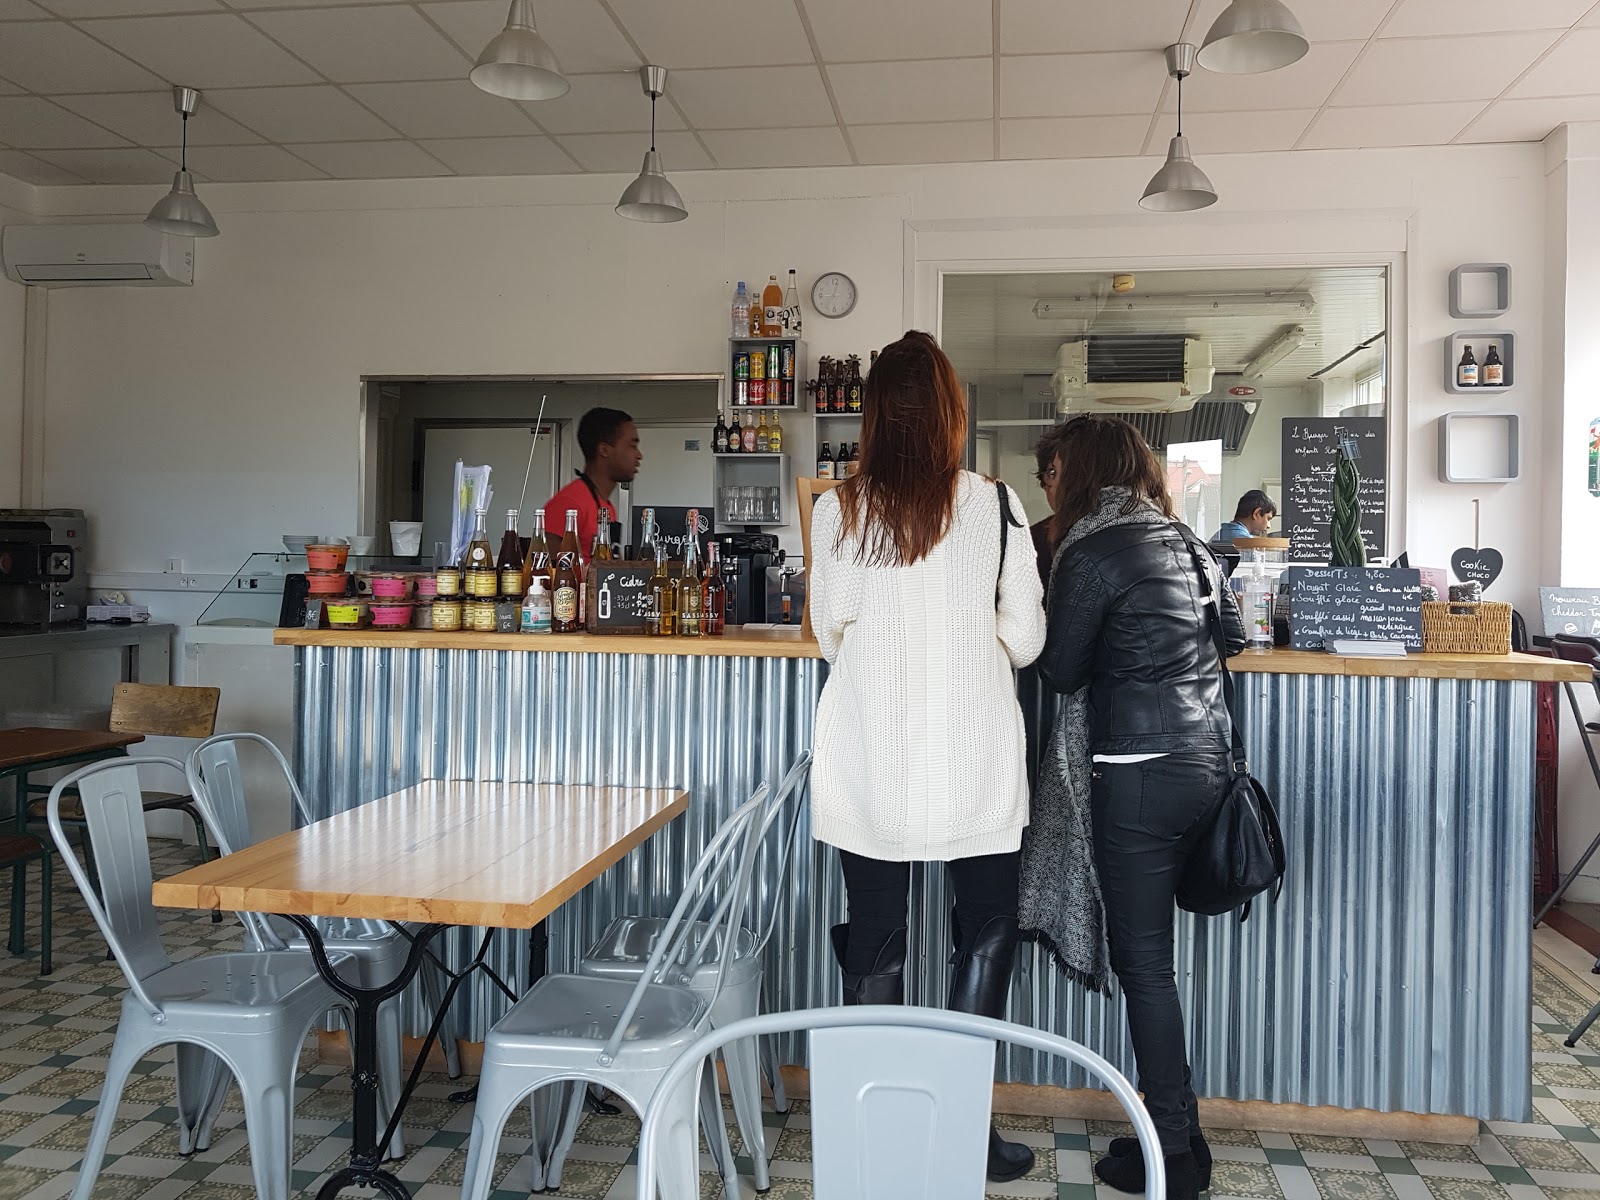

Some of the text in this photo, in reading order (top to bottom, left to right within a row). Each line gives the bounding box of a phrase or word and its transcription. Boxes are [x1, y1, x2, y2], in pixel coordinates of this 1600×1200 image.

[831, 278, 839, 286] 12
[620, 575, 645, 587] Cidre
[1297, 580, 1361, 594] Nougat Glacé
[1296, 593, 1331, 605] Soufflé
[1334, 595, 1361, 606] glacé
[1360, 604, 1385, 614] grand
[1299, 611, 1329, 624] Soufflé
[1302, 626, 1333, 637] Gaufre
